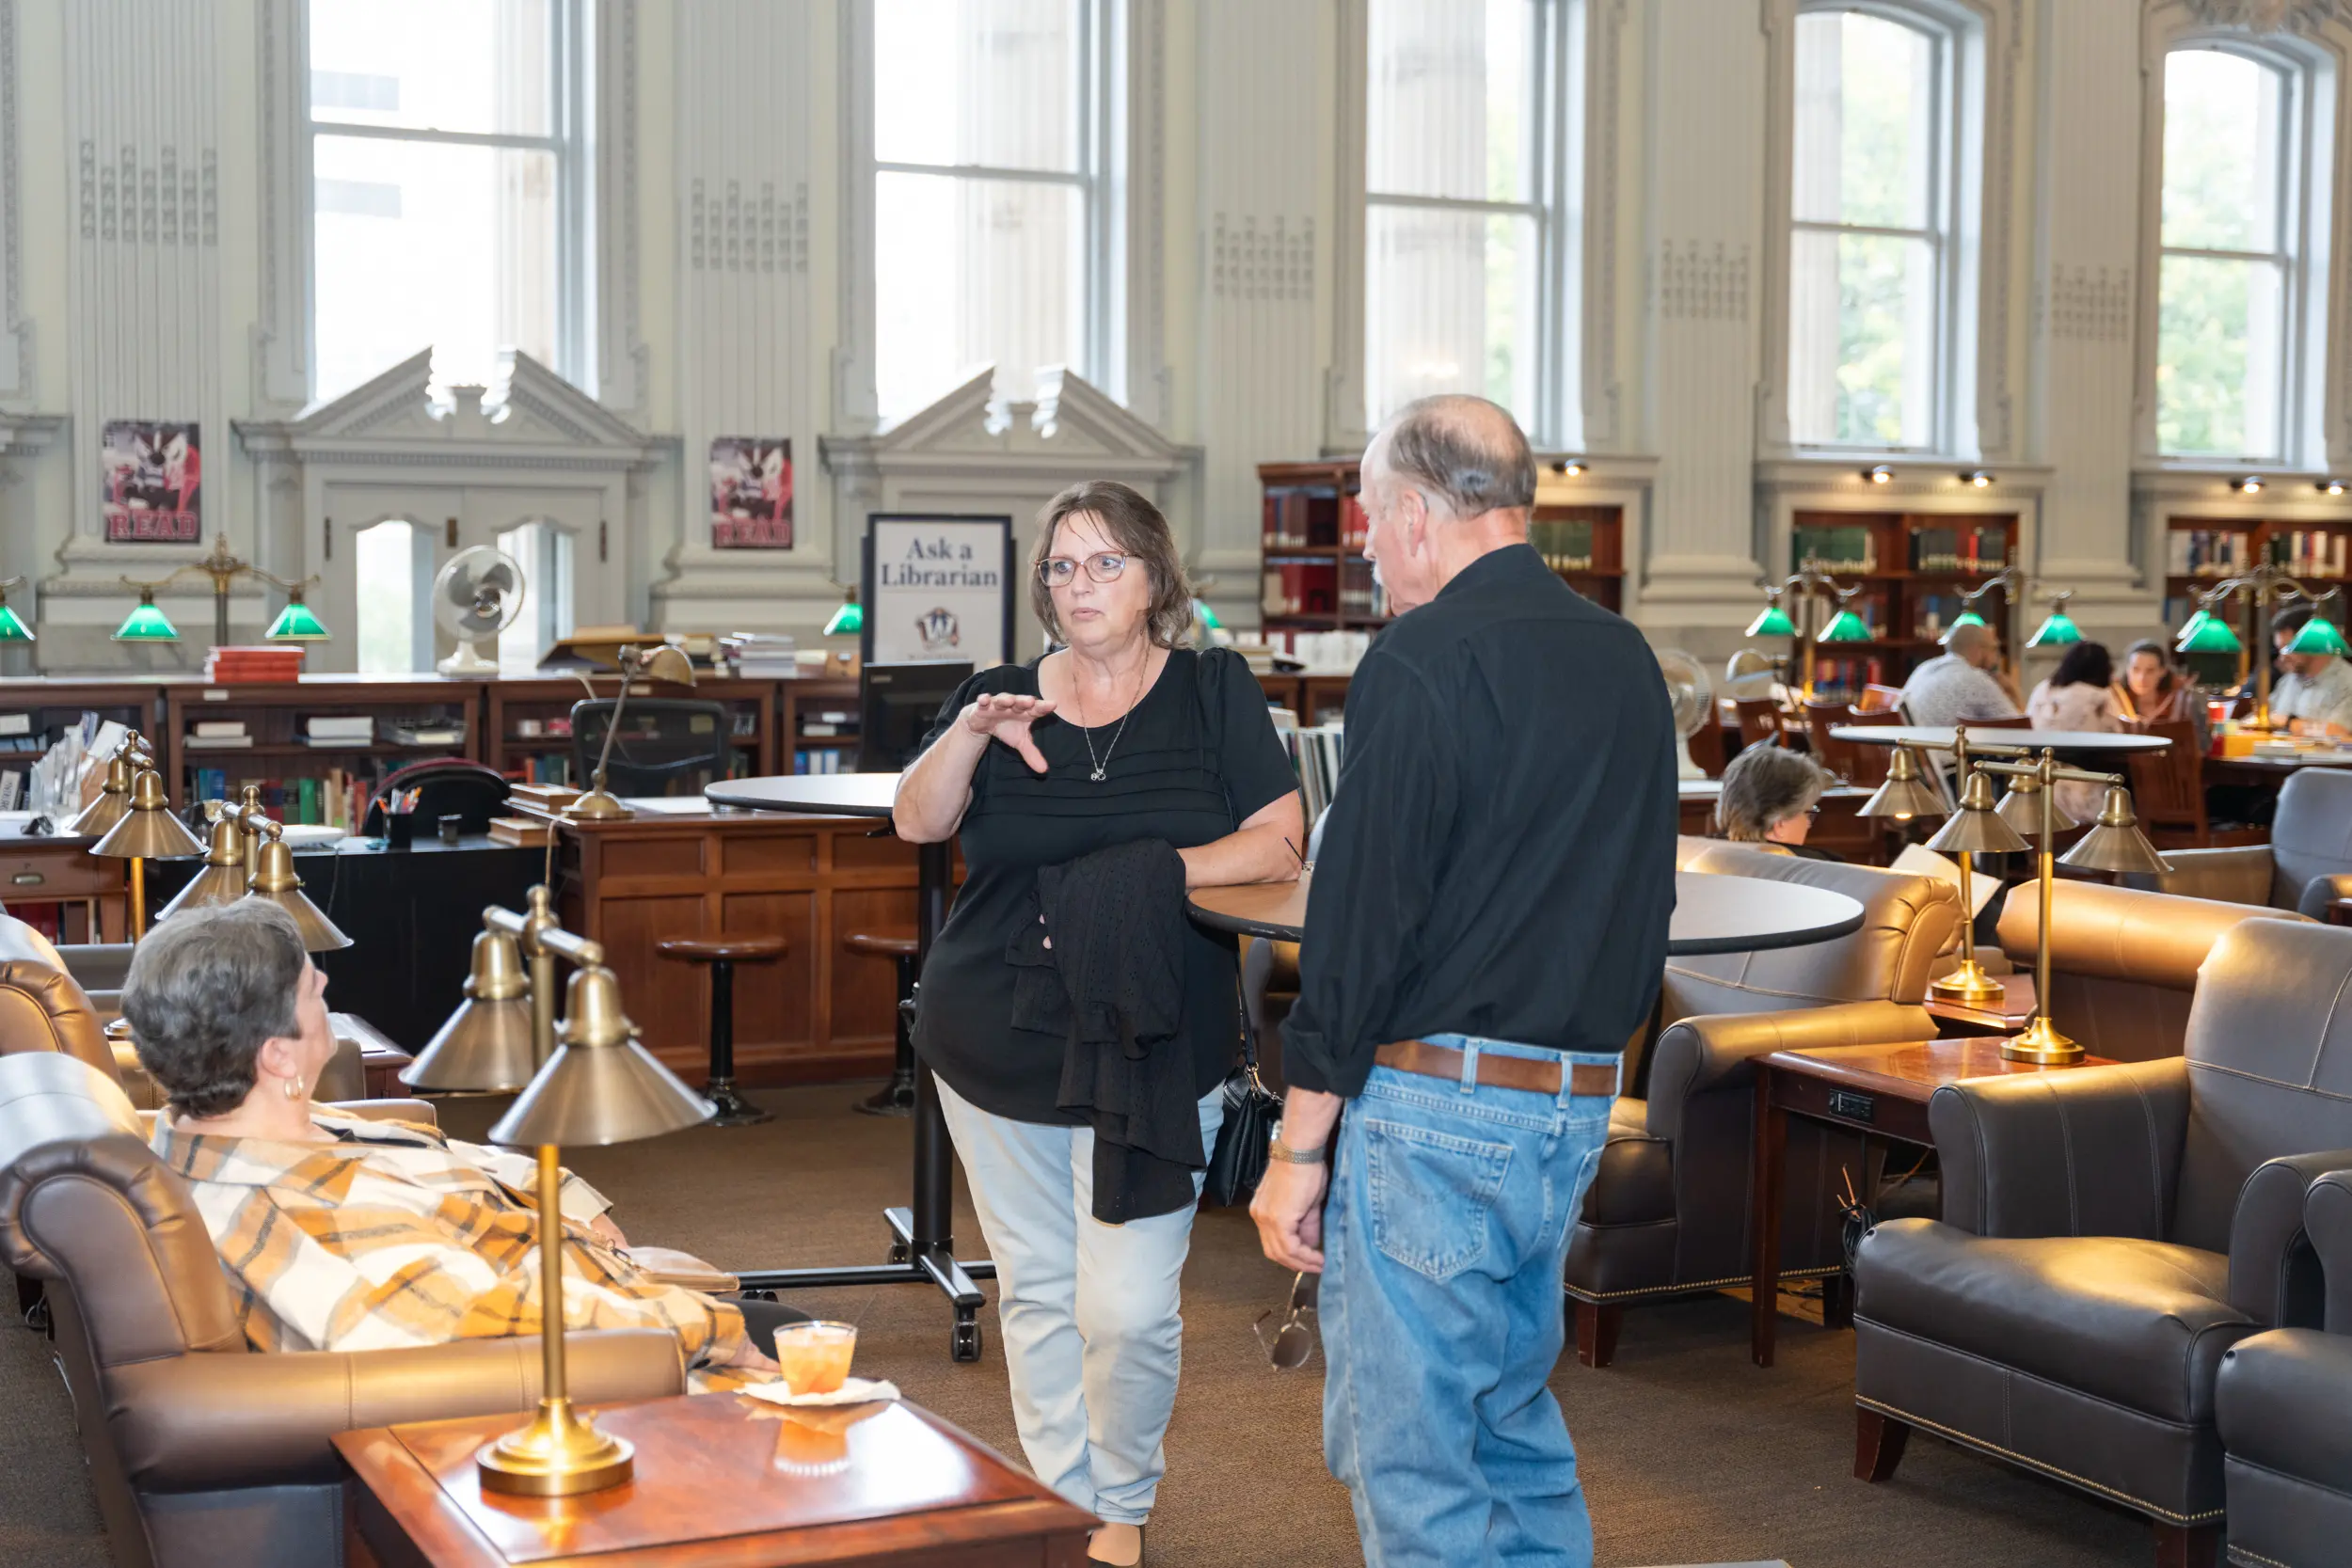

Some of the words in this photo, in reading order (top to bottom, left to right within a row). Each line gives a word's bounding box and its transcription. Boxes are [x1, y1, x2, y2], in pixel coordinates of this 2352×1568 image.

[109, 512, 198, 539] READ
[906, 536, 953, 561] Ask
[960, 543, 973, 561] a
[881, 563, 998, 587] Librarian
